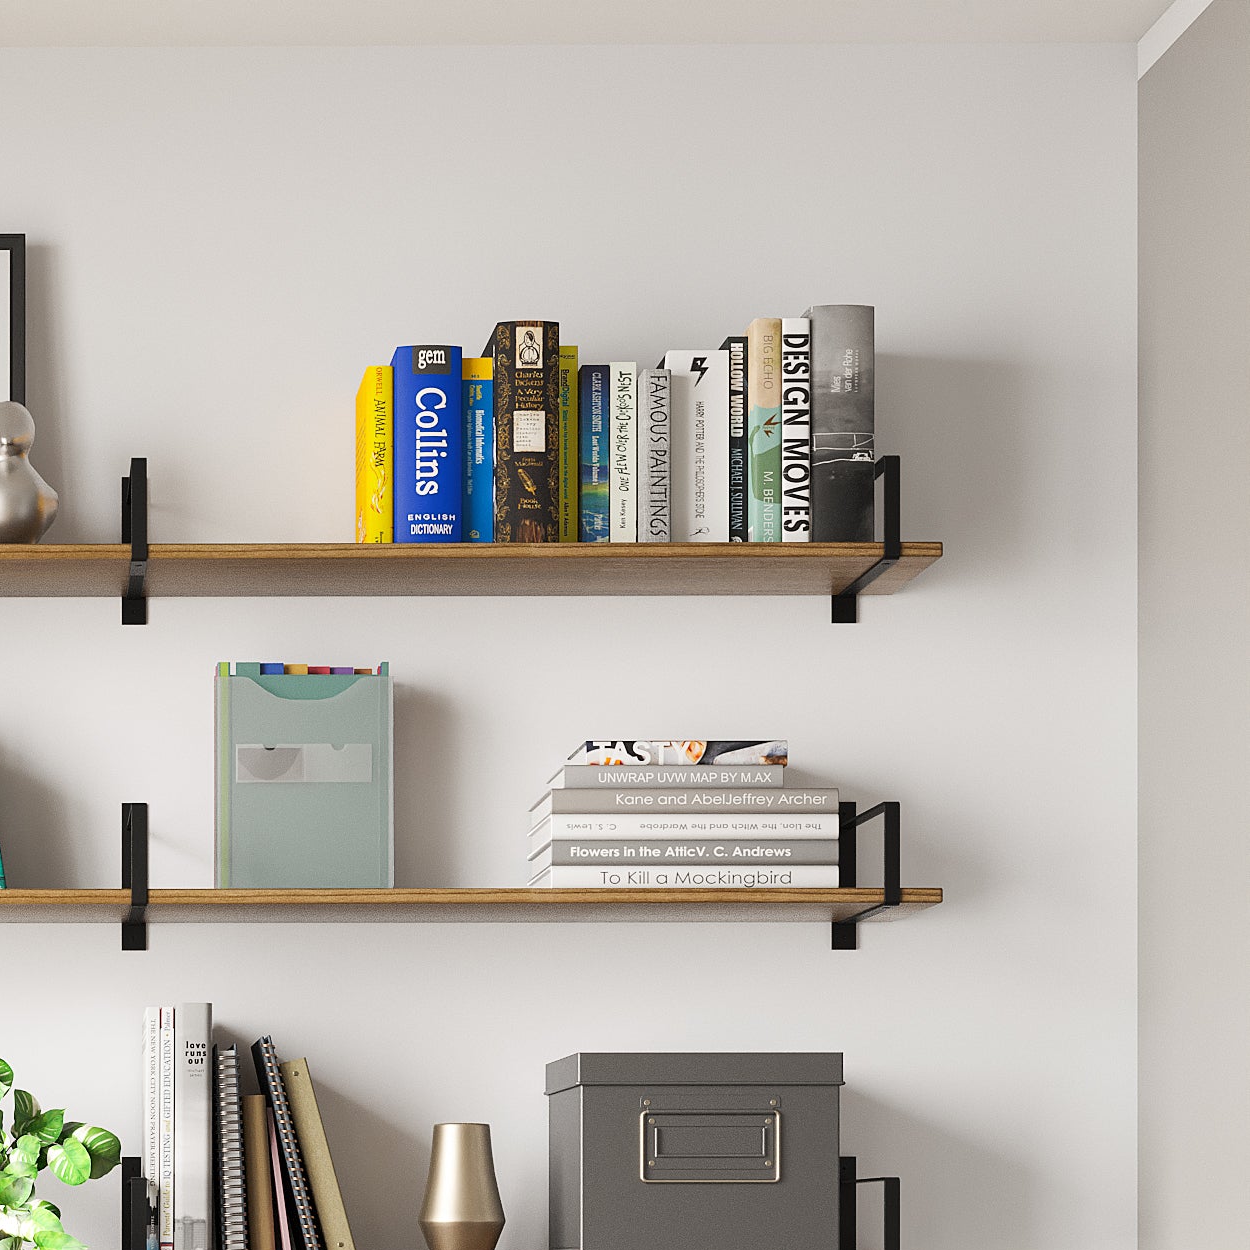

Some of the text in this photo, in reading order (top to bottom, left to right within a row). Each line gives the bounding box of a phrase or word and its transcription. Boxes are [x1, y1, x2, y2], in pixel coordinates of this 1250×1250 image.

[418, 349, 446, 369] gem
[763, 335, 774, 390] BIG ECHO
[515, 371, 544, 379] Charles
[842, 349, 853, 392] van der Rohe
[561, 369, 571, 406] BrandDigital
[617, 371, 632, 392] NEST
[730, 342, 744, 438] HOLLOW WORLD
[830, 376, 841, 393] Mies
[515, 403, 544, 411] History
[592, 372, 602, 432] CLARK ASHTON SMITH
[695, 400, 705, 417] HARRY
[476, 410, 485, 436] Biomedical
[616, 422, 629, 433] THE
[695, 419, 705, 440] POTTER
[374, 398, 386, 468] ANIMAL FARM
[415, 387, 448, 496] Collins
[783, 333, 810, 533] DESIGN MOVES
[476, 437, 485, 464] Informatics
[615, 434, 627, 453] OVER
[695, 442, 705, 453] AND
[650, 375, 668, 536] FAMOUS PAINTINGS
[695, 455, 705, 464] THE
[614, 455, 630, 476] FLEW
[731, 448, 743, 485] MICHAEL
[618, 477, 629, 492] ONE
[763, 471, 774, 485] M.
[619, 499, 627, 516] Kesey
[695, 504, 705, 518] STONE
[731, 492, 743, 530] SULLIVAN
[410, 524, 453, 535] DICTIONARY
[593, 741, 690, 766] TASTY
[598, 772, 772, 783] UNWRAP UVW MAP BY M.AX
[615, 793, 652, 805] Kane
[659, 793, 687, 805] and
[777, 793, 828, 805] Archer
[567, 822, 618, 831] C. S. Lewis
[640, 822, 688, 831] Wardrobe
[691, 822, 707, 830] the
[710, 822, 729, 830] and
[732, 822, 759, 831] Witch
[762, 822, 777, 830] the
[806, 822, 822, 830] The
[570, 846, 620, 857] Flowers
[624, 846, 635, 857] in
[639, 846, 661, 857] the
[713, 846, 729, 857] C.
[732, 846, 791, 857] Andrews
[600, 871, 792, 888] To Kill a Mockingbird
[162, 1012, 172, 1032] Palmer
[186, 1041, 206, 1049] love
[162, 1040, 172, 1089] EDUCATION
[162, 1090, 172, 1120] GIFTED
[162, 1121, 172, 1134] and
[162, 1135, 172, 1170] TESTING
[162, 1171, 172, 1181] IQ
[162, 1182, 172, 1190] to
[162, 1190, 172, 1210] Guide
